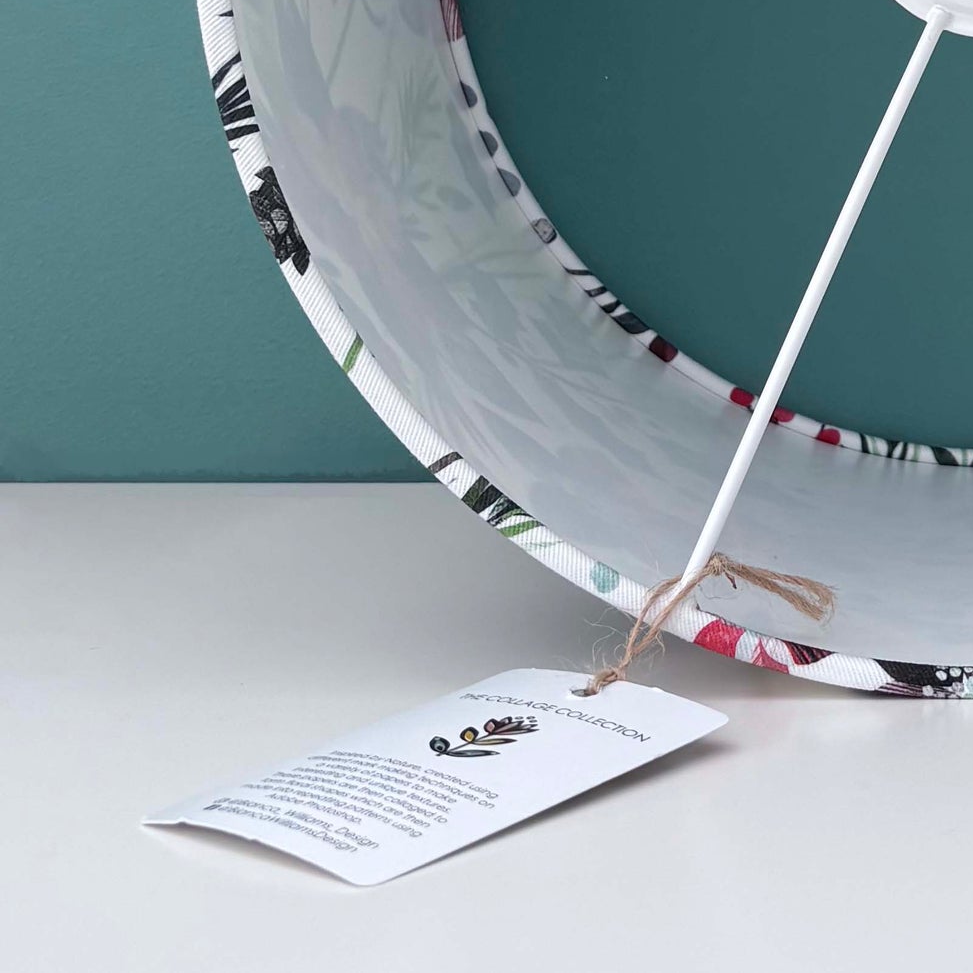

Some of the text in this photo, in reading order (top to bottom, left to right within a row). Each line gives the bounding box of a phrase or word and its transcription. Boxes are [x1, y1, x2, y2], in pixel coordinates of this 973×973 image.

[459, 693, 651, 743] THE COLLAGE COLLECTION
[345, 775, 372, 783] and
[368, 780, 407, 795] unique
[360, 768, 377, 776] of
[370, 772, 412, 787] papers
[411, 783, 425, 791] to
[424, 788, 457, 804] make
[376, 765, 419, 779] making
[418, 775, 479, 802] techniques
[477, 799, 496, 809] on
[424, 768, 472, 787] created
[469, 783, 499, 800] using
[338, 782, 359, 790] are
[357, 786, 385, 798] then
[383, 795, 437, 818] collaged
[434, 814, 448, 824] to
[344, 803, 393, 824] patterns
[391, 821, 423, 838] using
[350, 794, 384, 809] which
[383, 805, 404, 817] are
[403, 813, 431, 828] then
